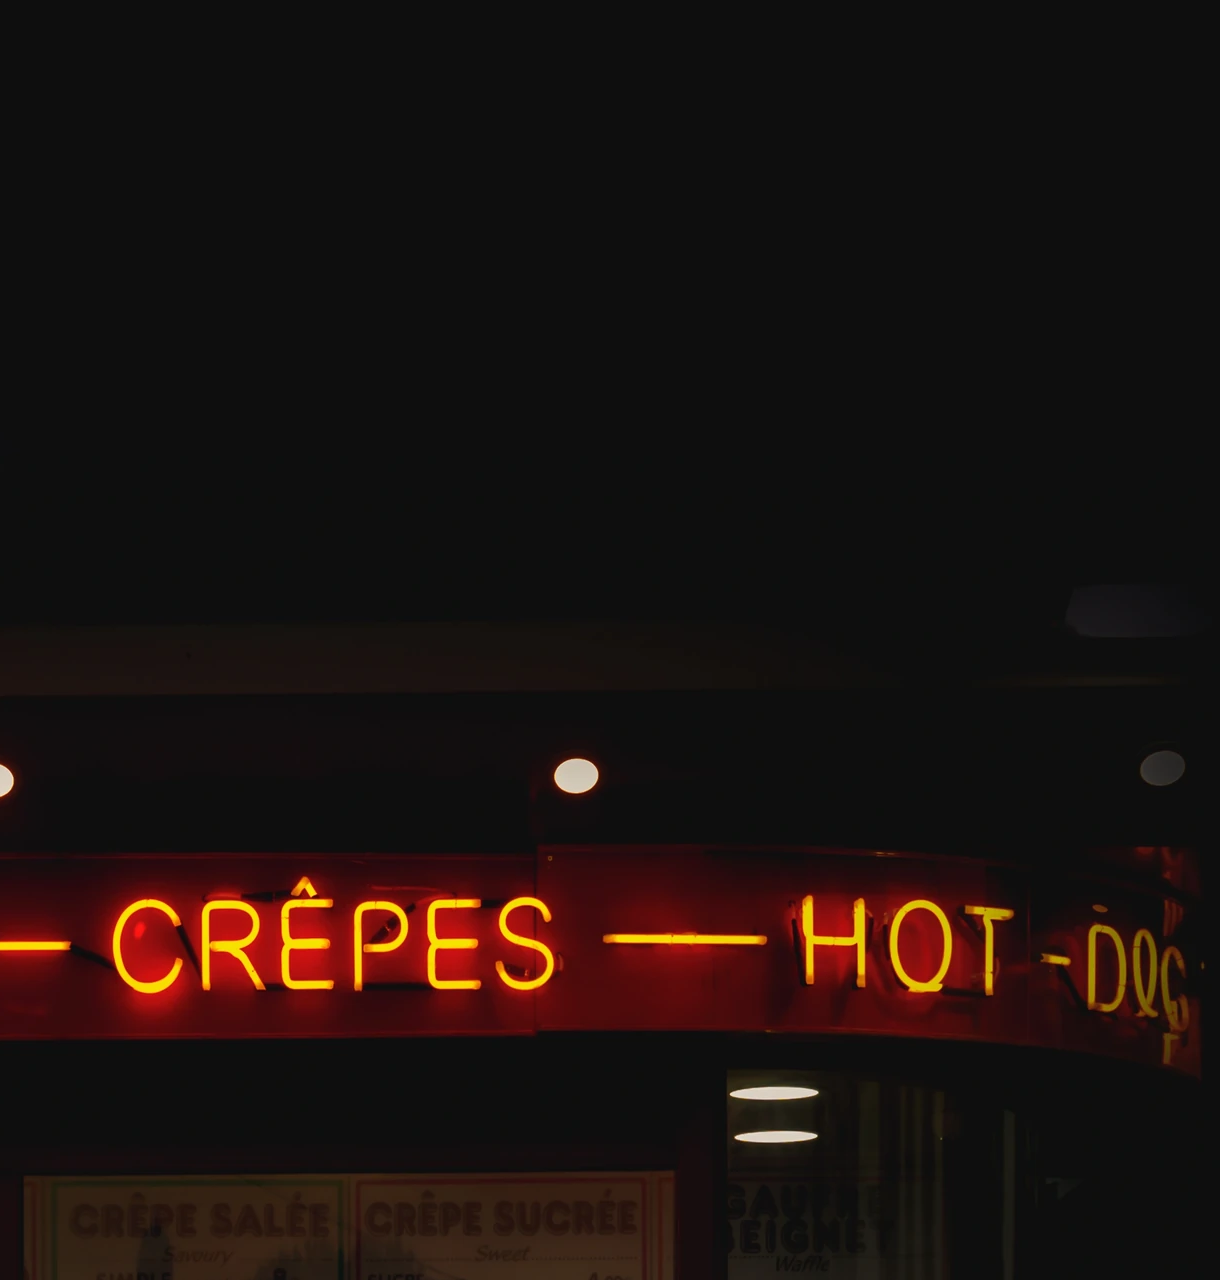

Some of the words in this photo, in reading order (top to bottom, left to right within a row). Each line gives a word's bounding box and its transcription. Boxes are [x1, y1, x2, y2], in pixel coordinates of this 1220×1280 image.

[111, 875, 560, 993] CRÊPES
[69, 1192, 198, 1238] CRÊPE
[209, 1191, 332, 1238] SALÉE
[363, 1190, 482, 1237] CRÊPE
[493, 1188, 639, 1236] SUCRÉE
[162, 1245, 234, 1267] Savoury
[474, 1244, 532, 1263] Sweet
[775, 1254, 830, 1273] Waffle
